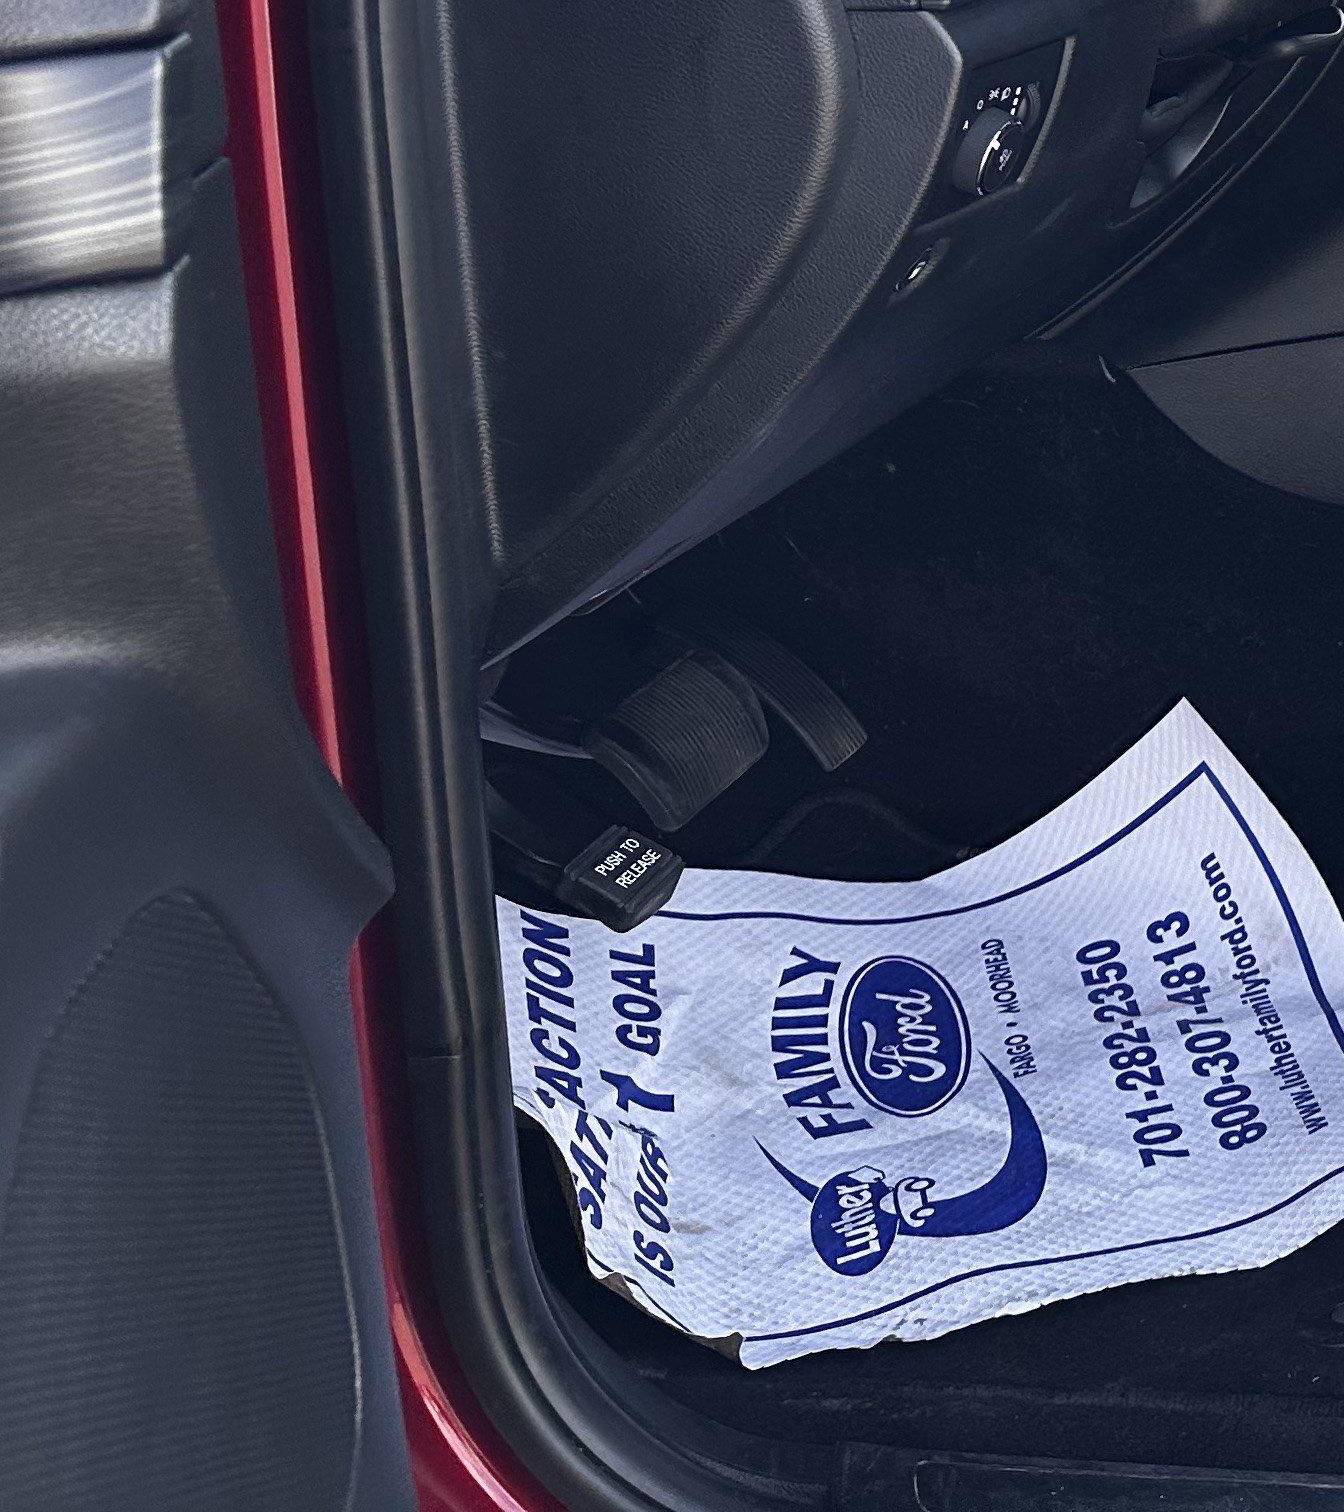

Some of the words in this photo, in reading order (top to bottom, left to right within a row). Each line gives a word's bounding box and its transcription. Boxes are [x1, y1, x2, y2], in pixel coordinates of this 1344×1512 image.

[594, 850, 627, 876] PUSH
[619, 838, 640, 853] TO
[615, 848, 662, 888] RELEASE
[608, 943, 663, 1057] GOAL
[980, 938, 1021, 1014] MOORHEAD
[1200, 852, 1329, 1135] www.lutherfamilyford.com
[770, 945, 874, 1140] FAMILY
[1003, 1033, 1038, 1080] FARGO
[1075, 938, 1190, 1168] 701-282-2350
[1146, 910, 1268, 1151] 800-307-4813
[633, 1133, 671, 1234] OUR
[830, 1183, 882, 1265] Luther
[633, 1230, 676, 1288] IS
